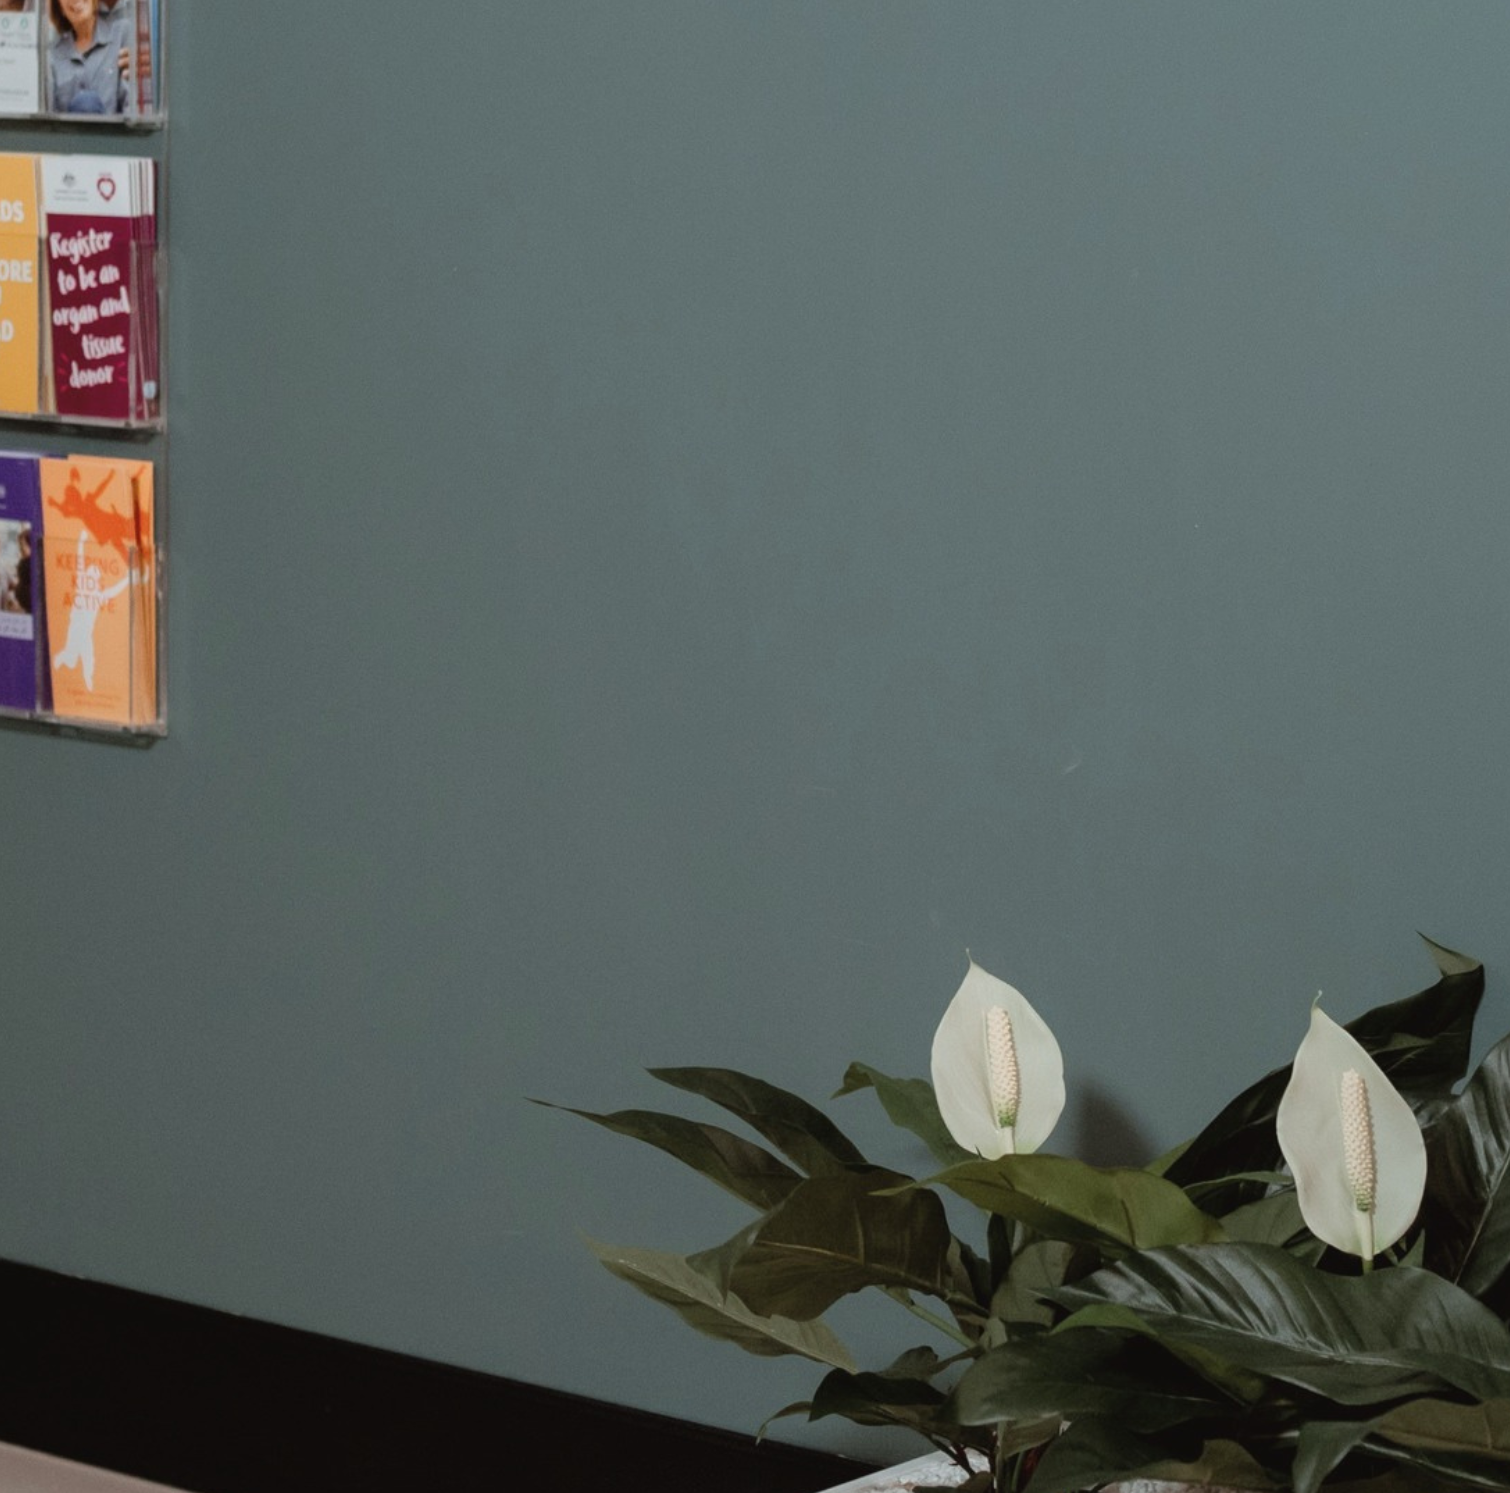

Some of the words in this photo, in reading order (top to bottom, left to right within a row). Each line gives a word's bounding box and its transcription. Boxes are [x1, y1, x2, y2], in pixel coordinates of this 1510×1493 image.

[50, 228, 113, 265] Register
[58, 269, 76, 295] to
[79, 265, 97, 291] be
[100, 265, 120, 285] an
[53, 305, 98, 334] organ
[100, 286, 130, 318] and
[82, 334, 125, 360] tissue
[70, 361, 114, 389] donor
[56, 553, 119, 575] KEEPING
